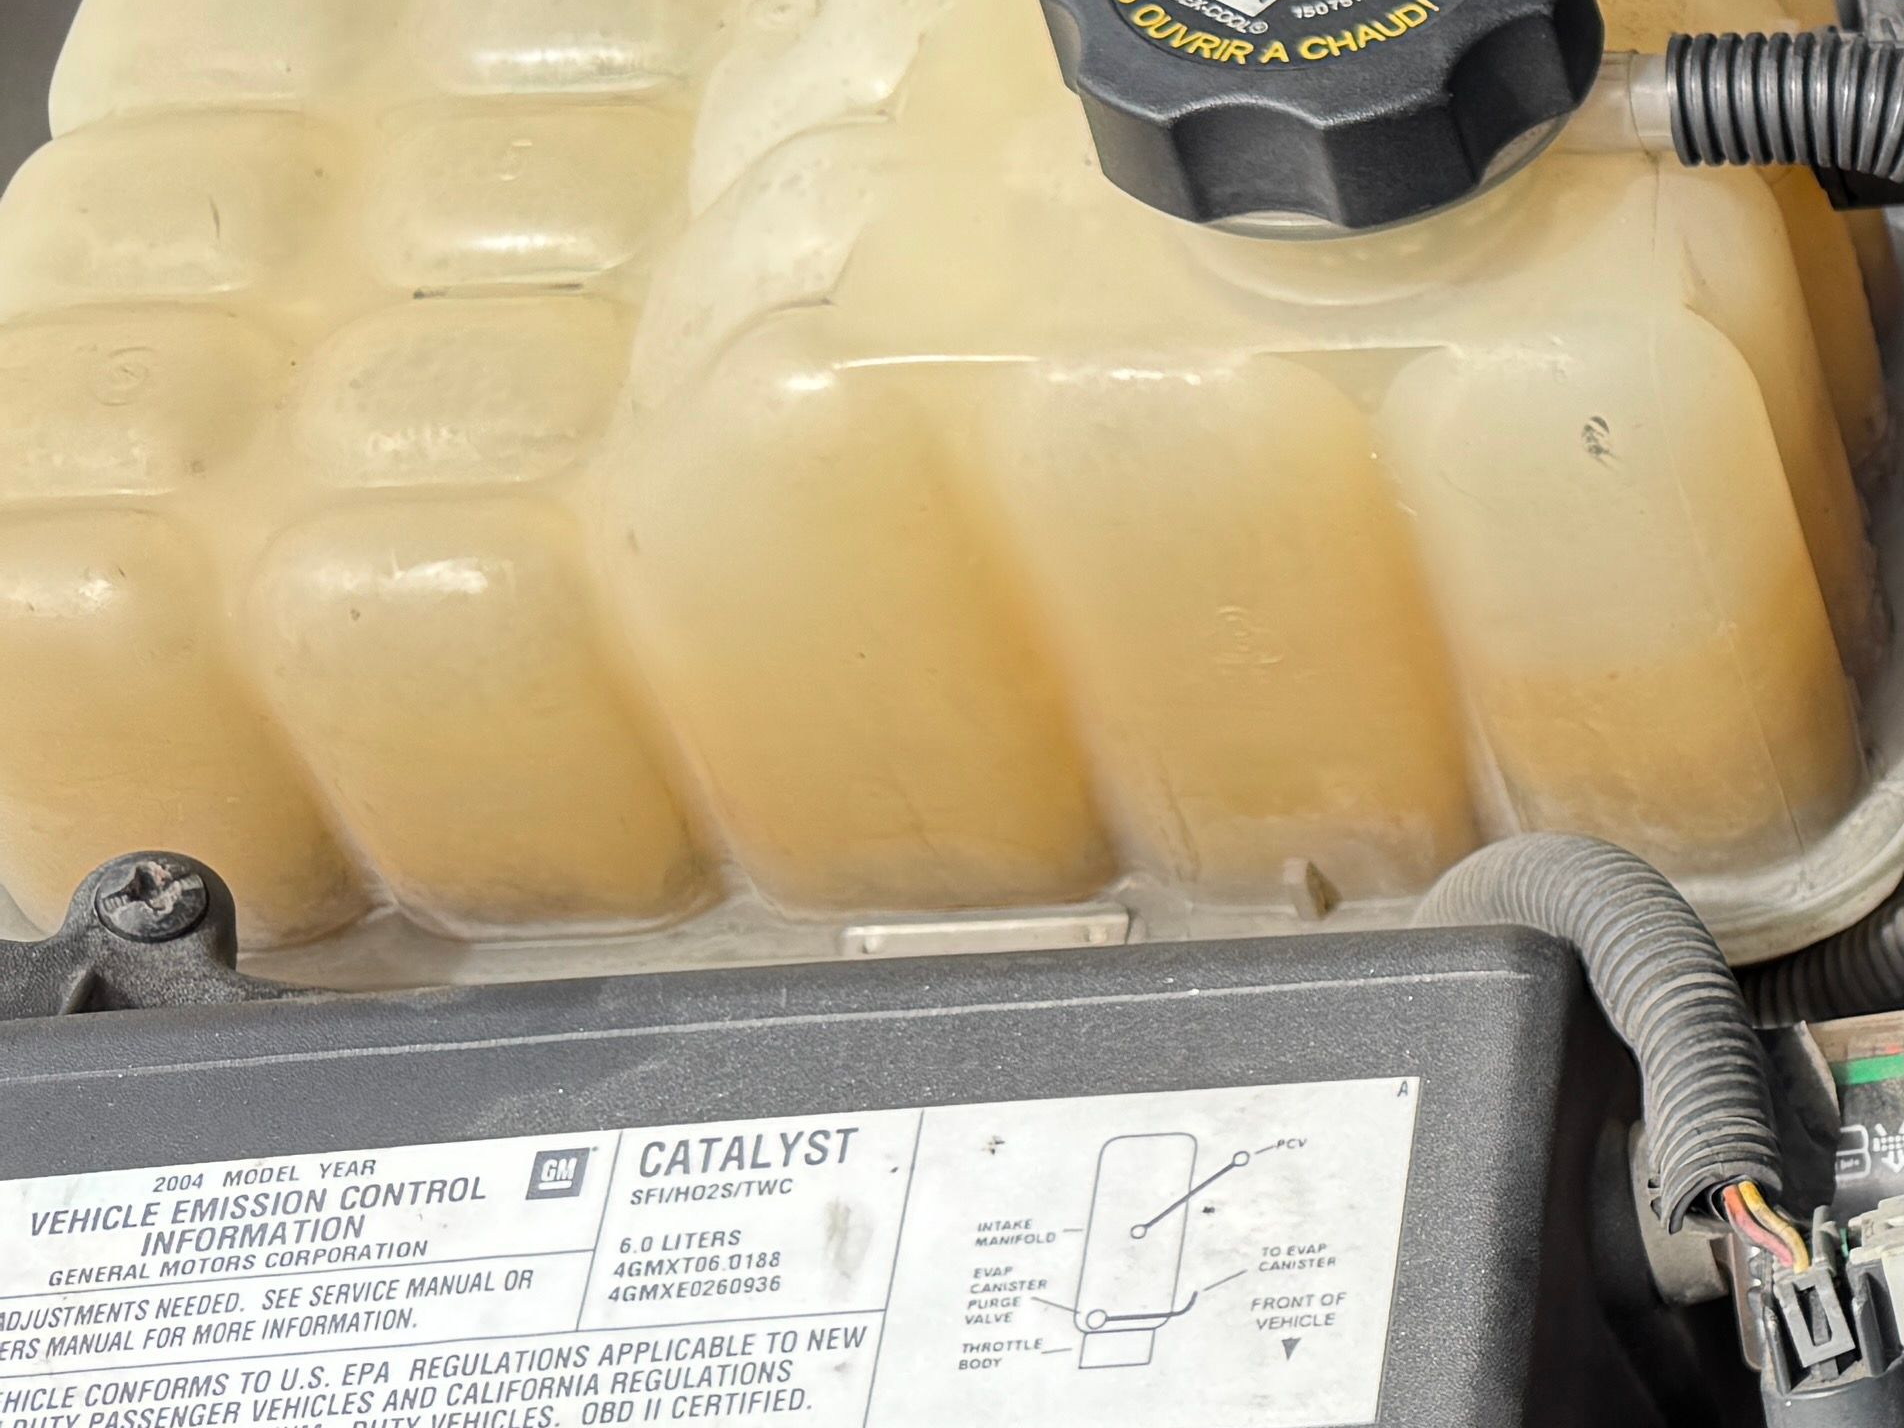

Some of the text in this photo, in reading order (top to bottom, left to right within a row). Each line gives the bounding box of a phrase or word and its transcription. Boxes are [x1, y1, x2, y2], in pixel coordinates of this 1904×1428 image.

[1131, 3, 1254, 65] OUVRIR
[1258, 41, 1290, 63] A
[1397, 1080, 1409, 1098] A
[639, 1127, 859, 1178] CATALYST
[1276, 1138, 1307, 1149] PCV
[153, 1159, 376, 1193] 2004 MODEL YEAR
[630, 1177, 794, 1205] SFI/HO2S/TWC
[31, 1176, 486, 1236] VEHICLE EMISSION CONTROL
[141, 1214, 366, 1257] INFORMATION
[977, 1219, 1033, 1232] INTAKE
[620, 1229, 742, 1254] 6.0 LITERS
[975, 1232, 1056, 1247] MANIFOLD
[1262, 1243, 1328, 1257] TO EVAP
[48, 1240, 428, 1287] GENERAL MOTORS CORPORATION
[613, 1251, 781, 1278] 4GMXT06.0188
[973, 1266, 1013, 1279] EVAP
[1258, 1257, 1337, 1272] CANISTER
[155, 1292, 246, 1320] NEEDED.
[262, 1287, 303, 1310] SEE
[309, 1279, 400, 1307] SERVICE
[406, 1270, 495, 1299] MANUAL
[504, 1269, 534, 1292] OR
[608, 1275, 782, 1302] 4GMXE0260936
[970, 1279, 1048, 1294] CANISTER
[968, 1296, 1022, 1310] PURGE
[1250, 1292, 1347, 1311] FRONT OF
[964, 1312, 1013, 1325] VALVE
[1256, 1312, 1337, 1330] VEHICLE
[46, 1330, 135, 1359] MANUAL
[143, 1325, 187, 1350] FOR
[192, 1320, 257, 1345] MORE
[262, 1307, 418, 1341] INFORMATION.
[962, 1338, 1044, 1354] THROTTLE
[0, 1325, 868, 1413] HICLE CONFORMS TO U.S. EPA REGULATIONS APPLICABLE TO NEW
[958, 1358, 1002, 1370] BODY
[252, 1390, 375, 1422] VEHICLES
[382, 1386, 437, 1413] AND
[446, 1372, 600, 1407] CALIFORNIA
[610, 1359, 794, 1395] REGULATIONS
[582, 1400, 634, 1425] OBD
[643, 1397, 662, 1421] II
[671, 1388, 812, 1419] CERTIFIED.
